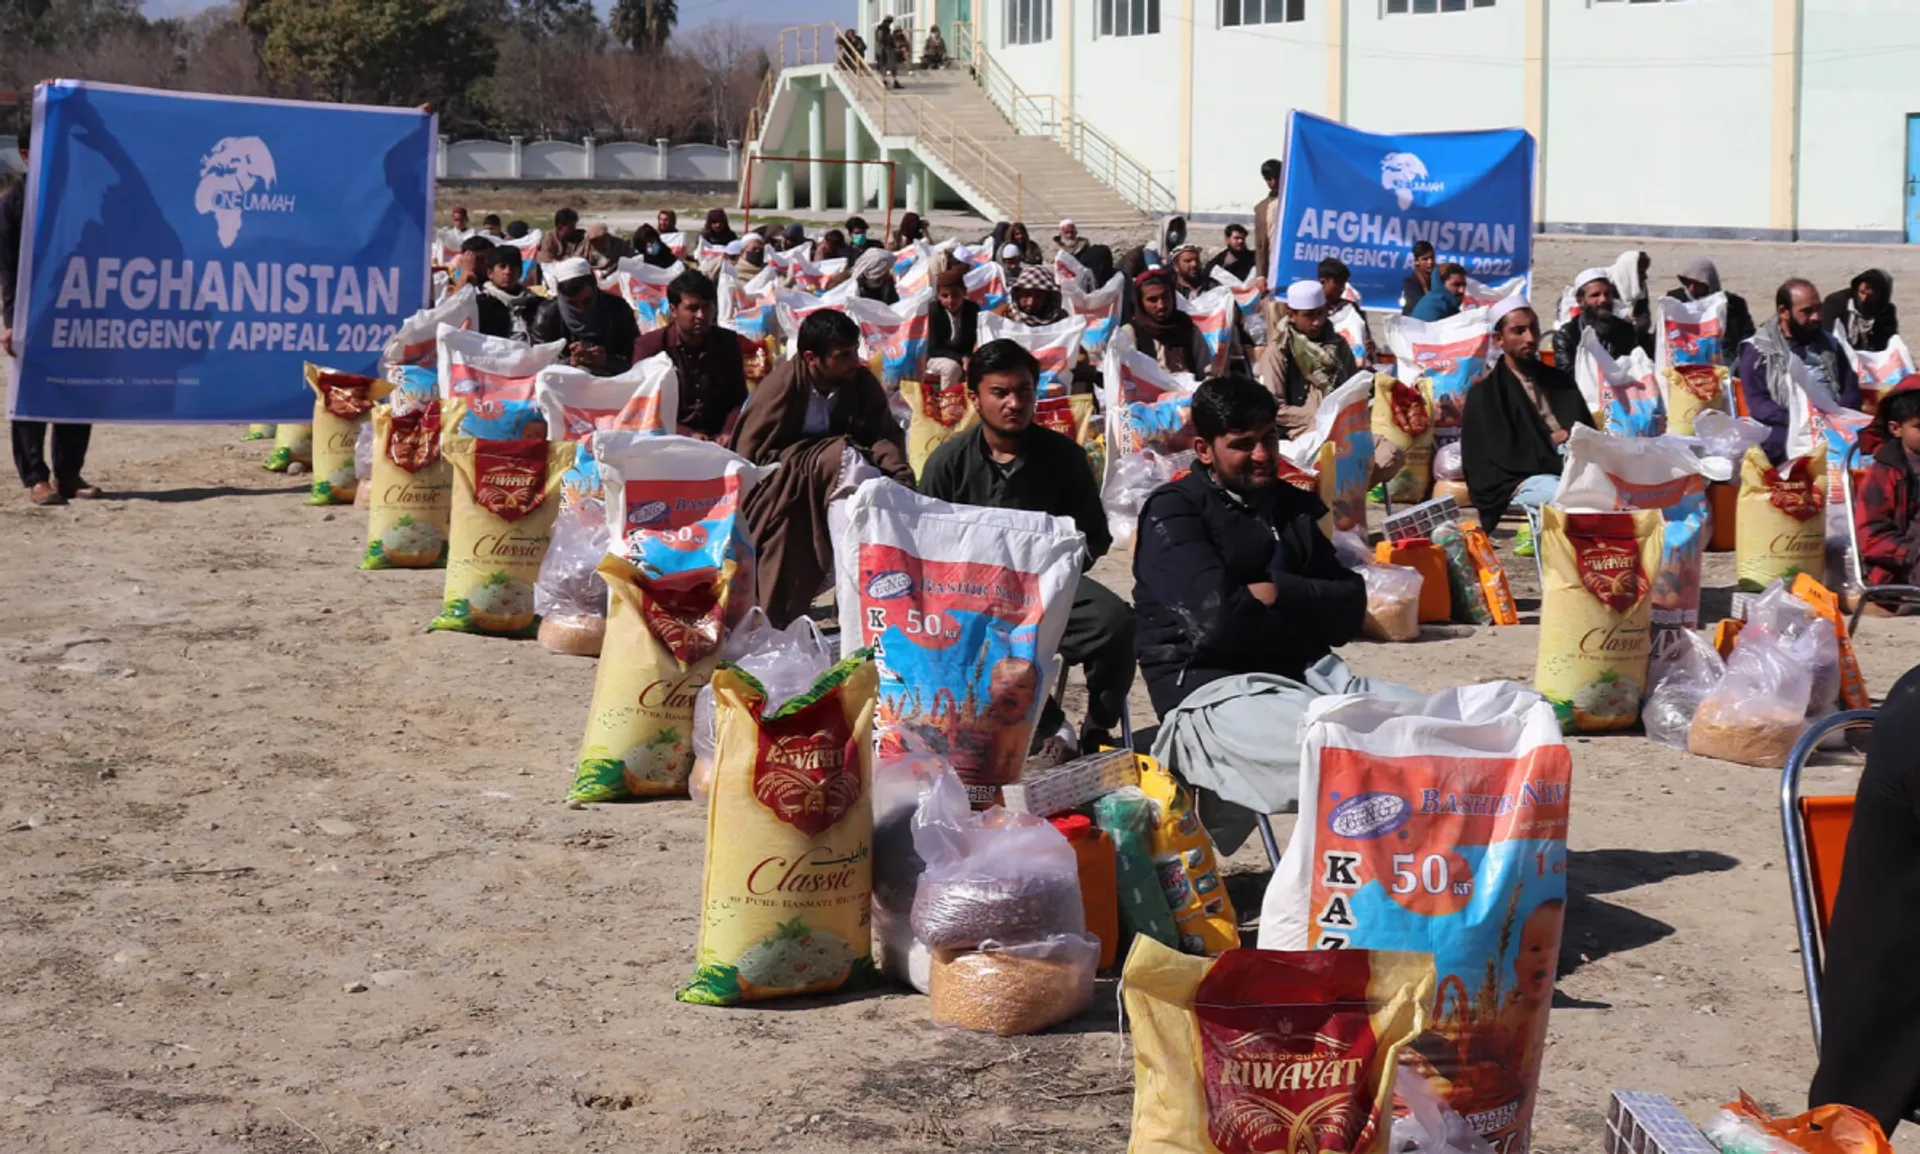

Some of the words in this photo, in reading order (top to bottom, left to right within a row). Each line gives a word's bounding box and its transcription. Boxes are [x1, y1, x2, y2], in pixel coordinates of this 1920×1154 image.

[1297, 207, 1515, 254] AFGHANISTAN
[1294, 242, 1399, 269] EMERGENCY
[1472, 257, 1512, 276] 2022
[55, 256, 399, 315] AFGHANISTAN
[52, 318, 222, 350] EMERGENCY
[227, 321, 330, 352] APPEAL
[335, 323, 397, 352] 2022
[473, 528, 541, 558] Classic
[906, 609, 942, 636] 50
[1419, 787, 1513, 817] BASHIR
[747, 846, 855, 895] Classic
[1391, 852, 1449, 895] 50
[745, 896, 775, 907] PURE
[782, 899, 832, 909] BASMATI
[1220, 1057, 1363, 1090] RIWAYAT
